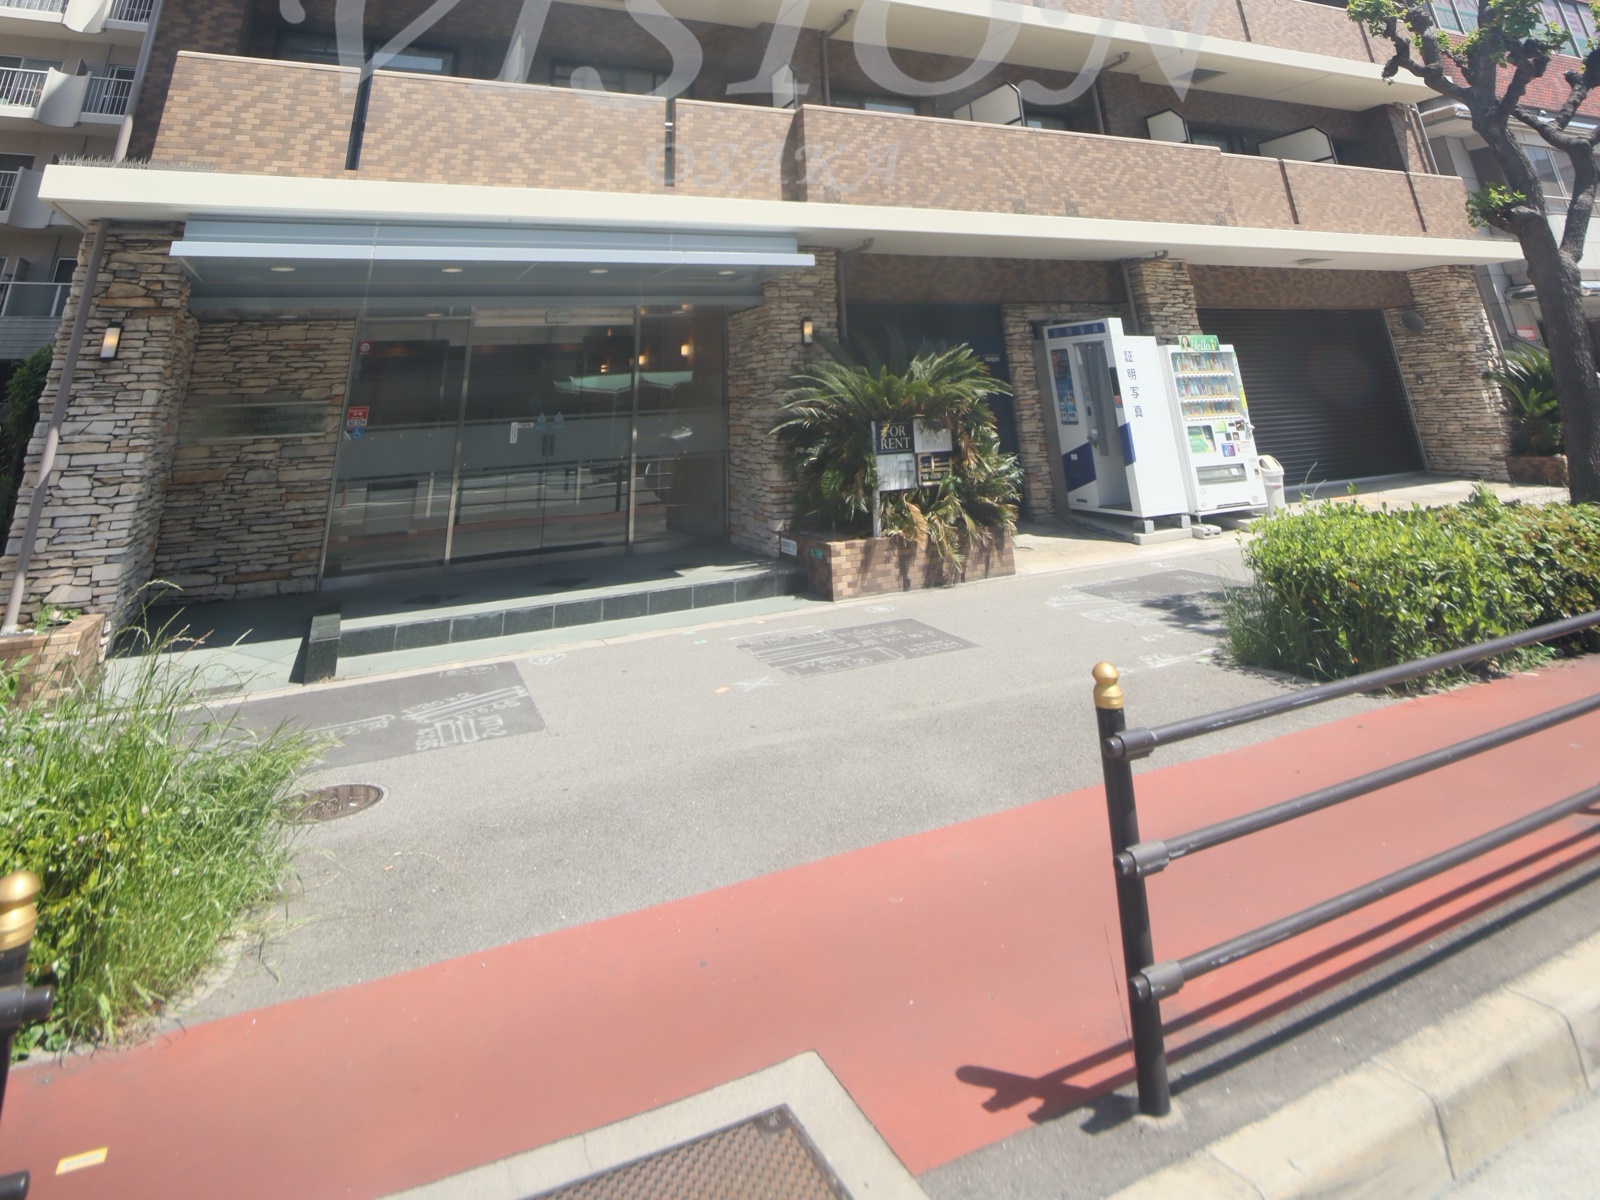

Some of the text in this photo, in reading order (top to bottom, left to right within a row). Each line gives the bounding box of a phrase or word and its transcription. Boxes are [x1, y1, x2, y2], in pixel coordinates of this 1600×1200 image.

[1123, 350, 1143, 418] 証明写真
[881, 425, 906, 438] OR
[881, 437, 910, 450] RENT
